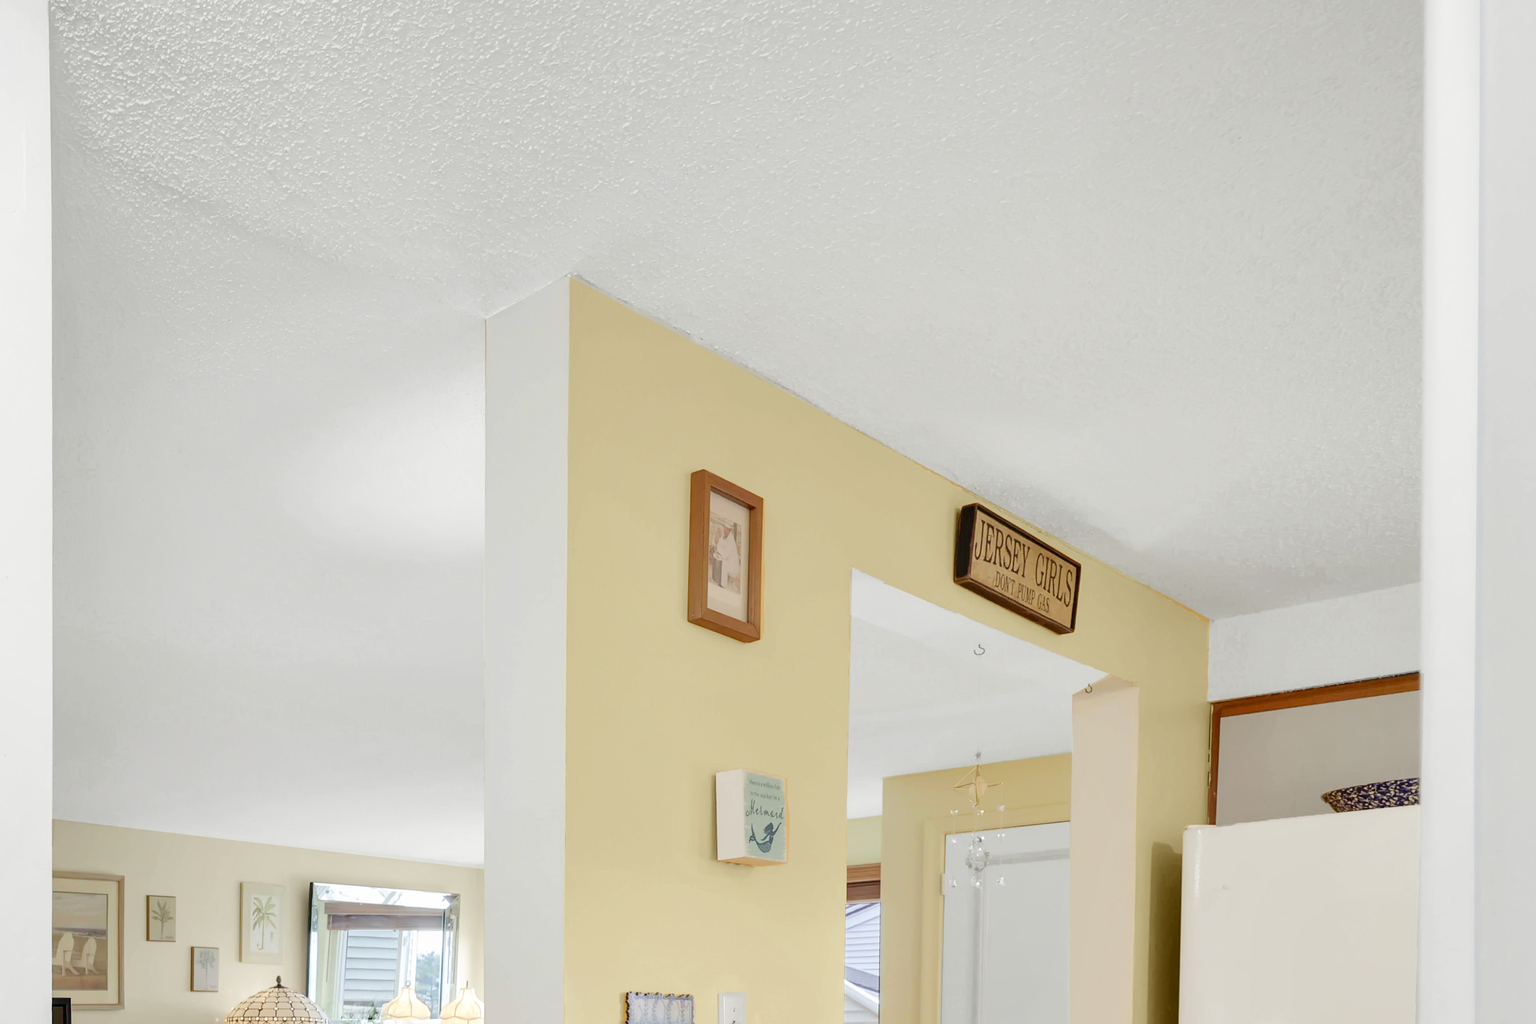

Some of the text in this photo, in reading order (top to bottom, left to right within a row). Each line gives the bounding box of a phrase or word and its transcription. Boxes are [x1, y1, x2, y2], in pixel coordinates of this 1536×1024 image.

[974, 519, 1073, 608] JERSEY GIRLS
[1017, 583, 1036, 606] PUMP
[1037, 593, 1051, 614] GAS
